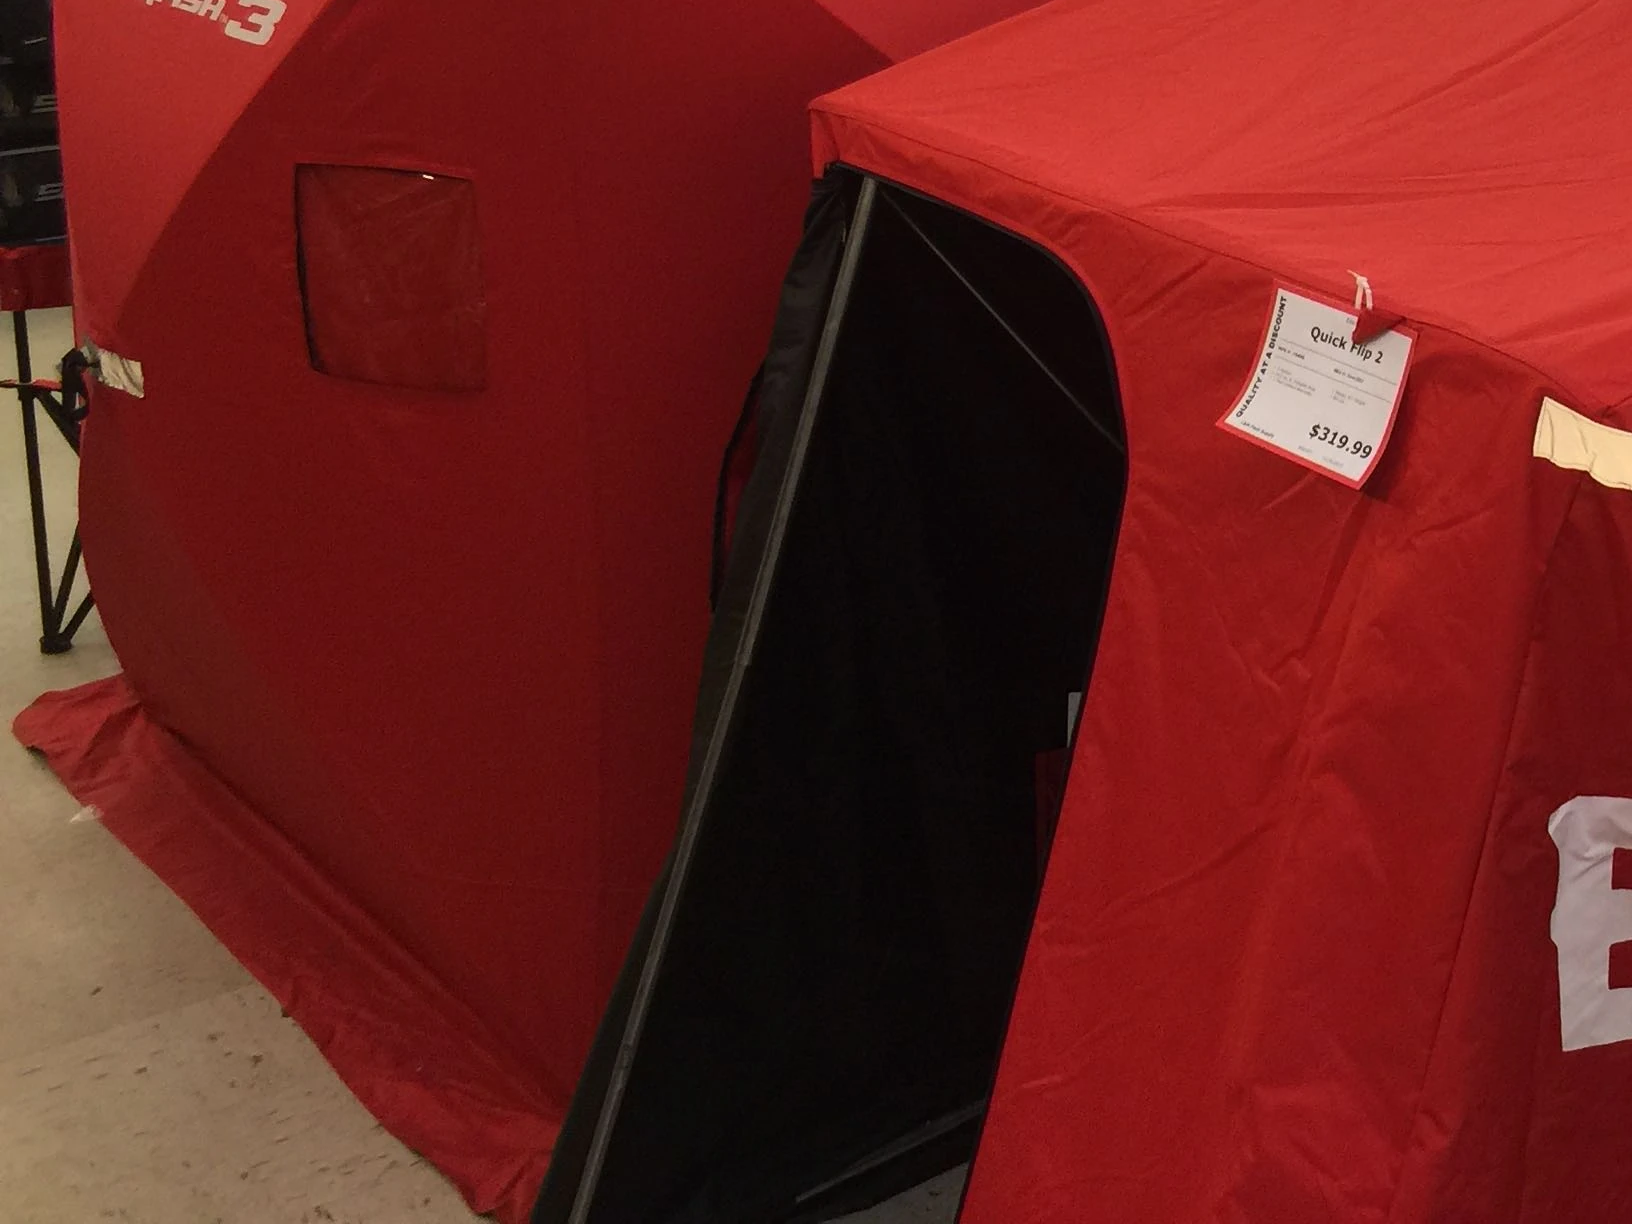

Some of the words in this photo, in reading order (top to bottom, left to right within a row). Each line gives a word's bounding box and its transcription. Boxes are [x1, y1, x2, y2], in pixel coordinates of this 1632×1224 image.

[1268, 295, 1287, 350] DISCOUNT
[1266, 351, 1273, 360] A
[1310, 326, 1348, 351] Quick
[1349, 341, 1373, 362] Flip
[1375, 350, 1384, 364] 2
[1260, 360, 1269, 375] AT
[1236, 376, 1262, 418] QUALITY
[1308, 423, 1374, 460] $319.99
